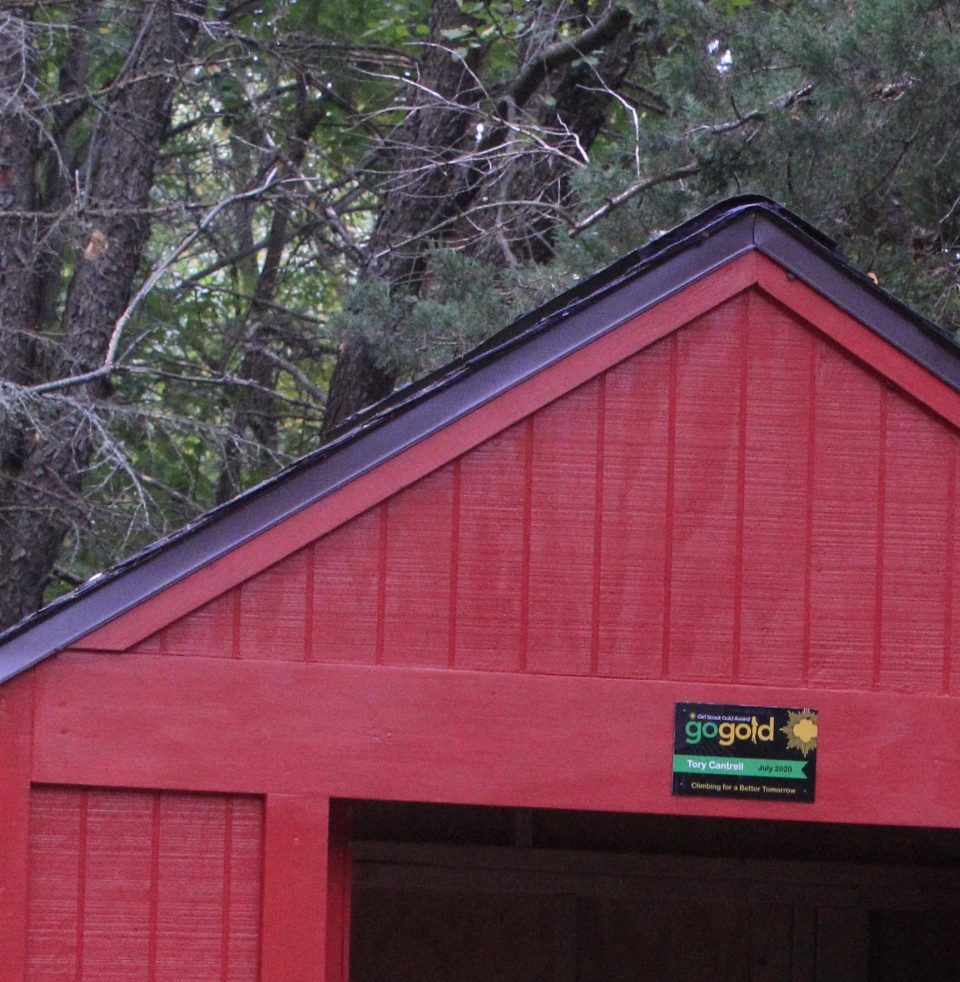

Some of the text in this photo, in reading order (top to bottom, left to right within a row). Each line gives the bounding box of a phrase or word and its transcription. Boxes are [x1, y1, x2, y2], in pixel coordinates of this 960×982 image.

[687, 759, 792, 773] Tory Cantrell July 2020
[690, 781, 721, 791] Climbing
[739, 784, 761, 792] Better
[762, 786, 796, 794] Tomorrow
